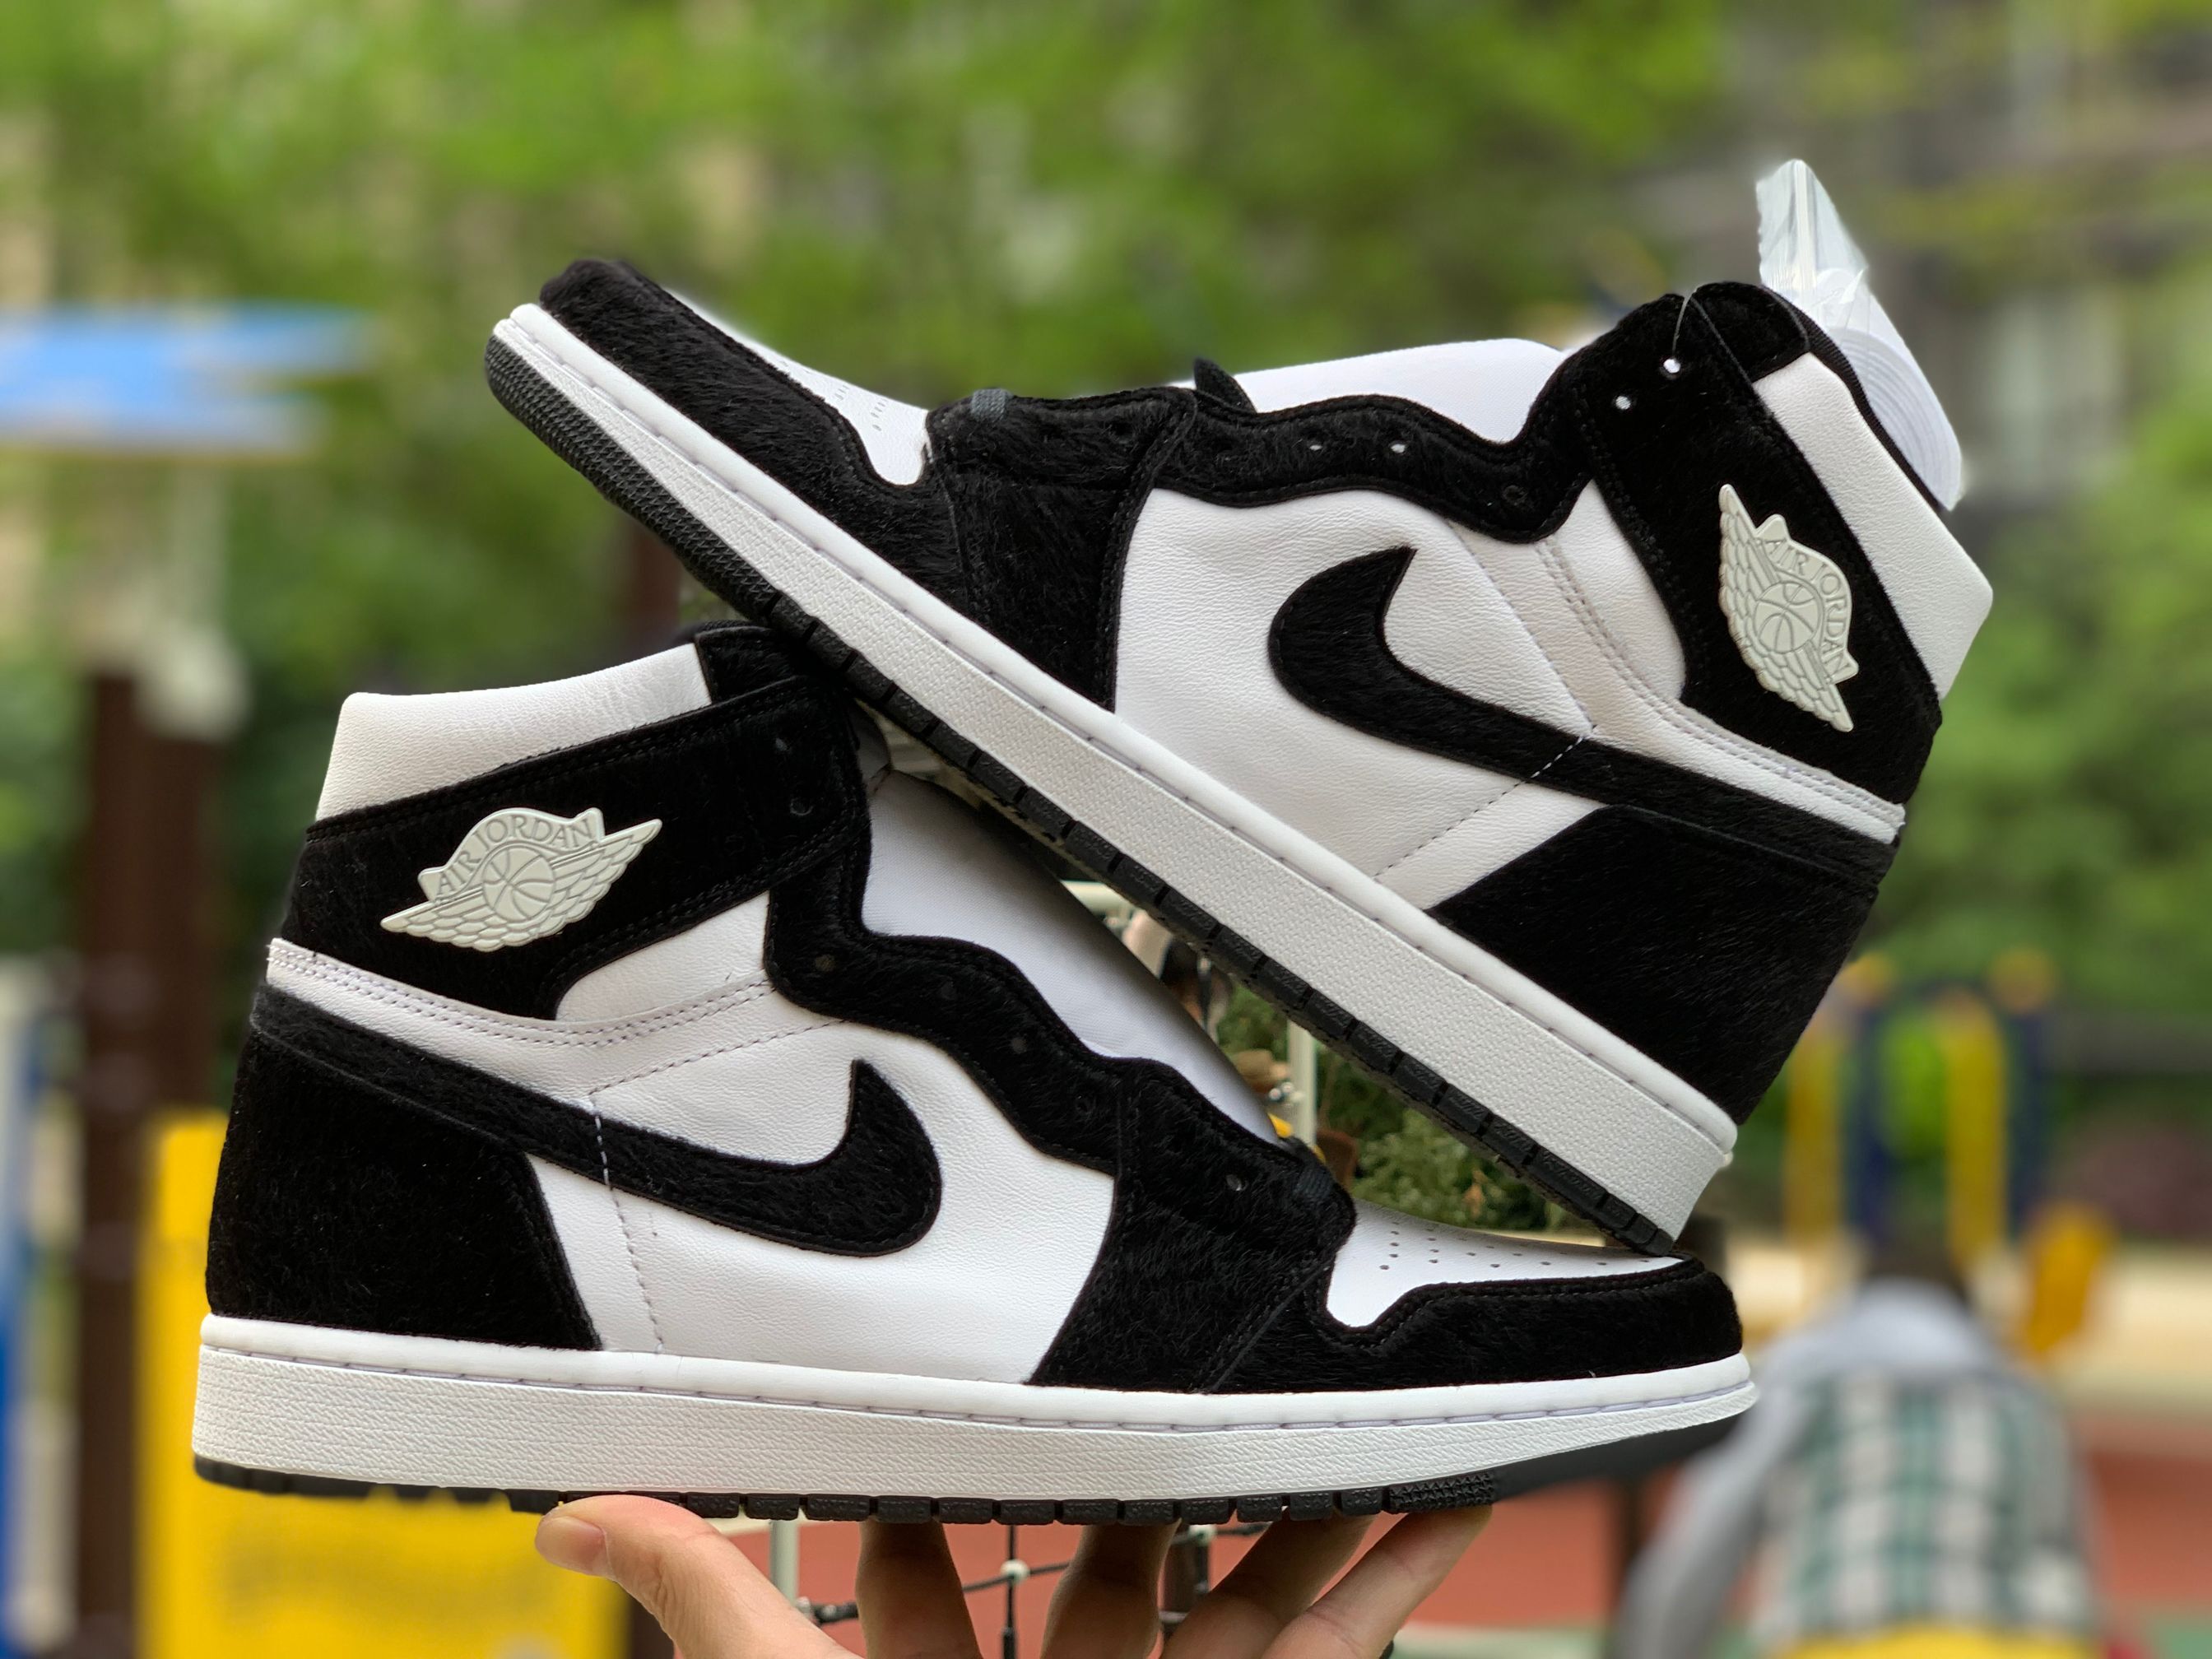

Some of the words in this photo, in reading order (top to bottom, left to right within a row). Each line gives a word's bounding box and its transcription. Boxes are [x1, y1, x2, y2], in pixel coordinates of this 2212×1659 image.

[1767, 539, 1808, 576] AIR
[1811, 563, 1850, 676] JORDAN
[437, 851, 481, 895] AIR
[472, 815, 593, 850] JORDAN
